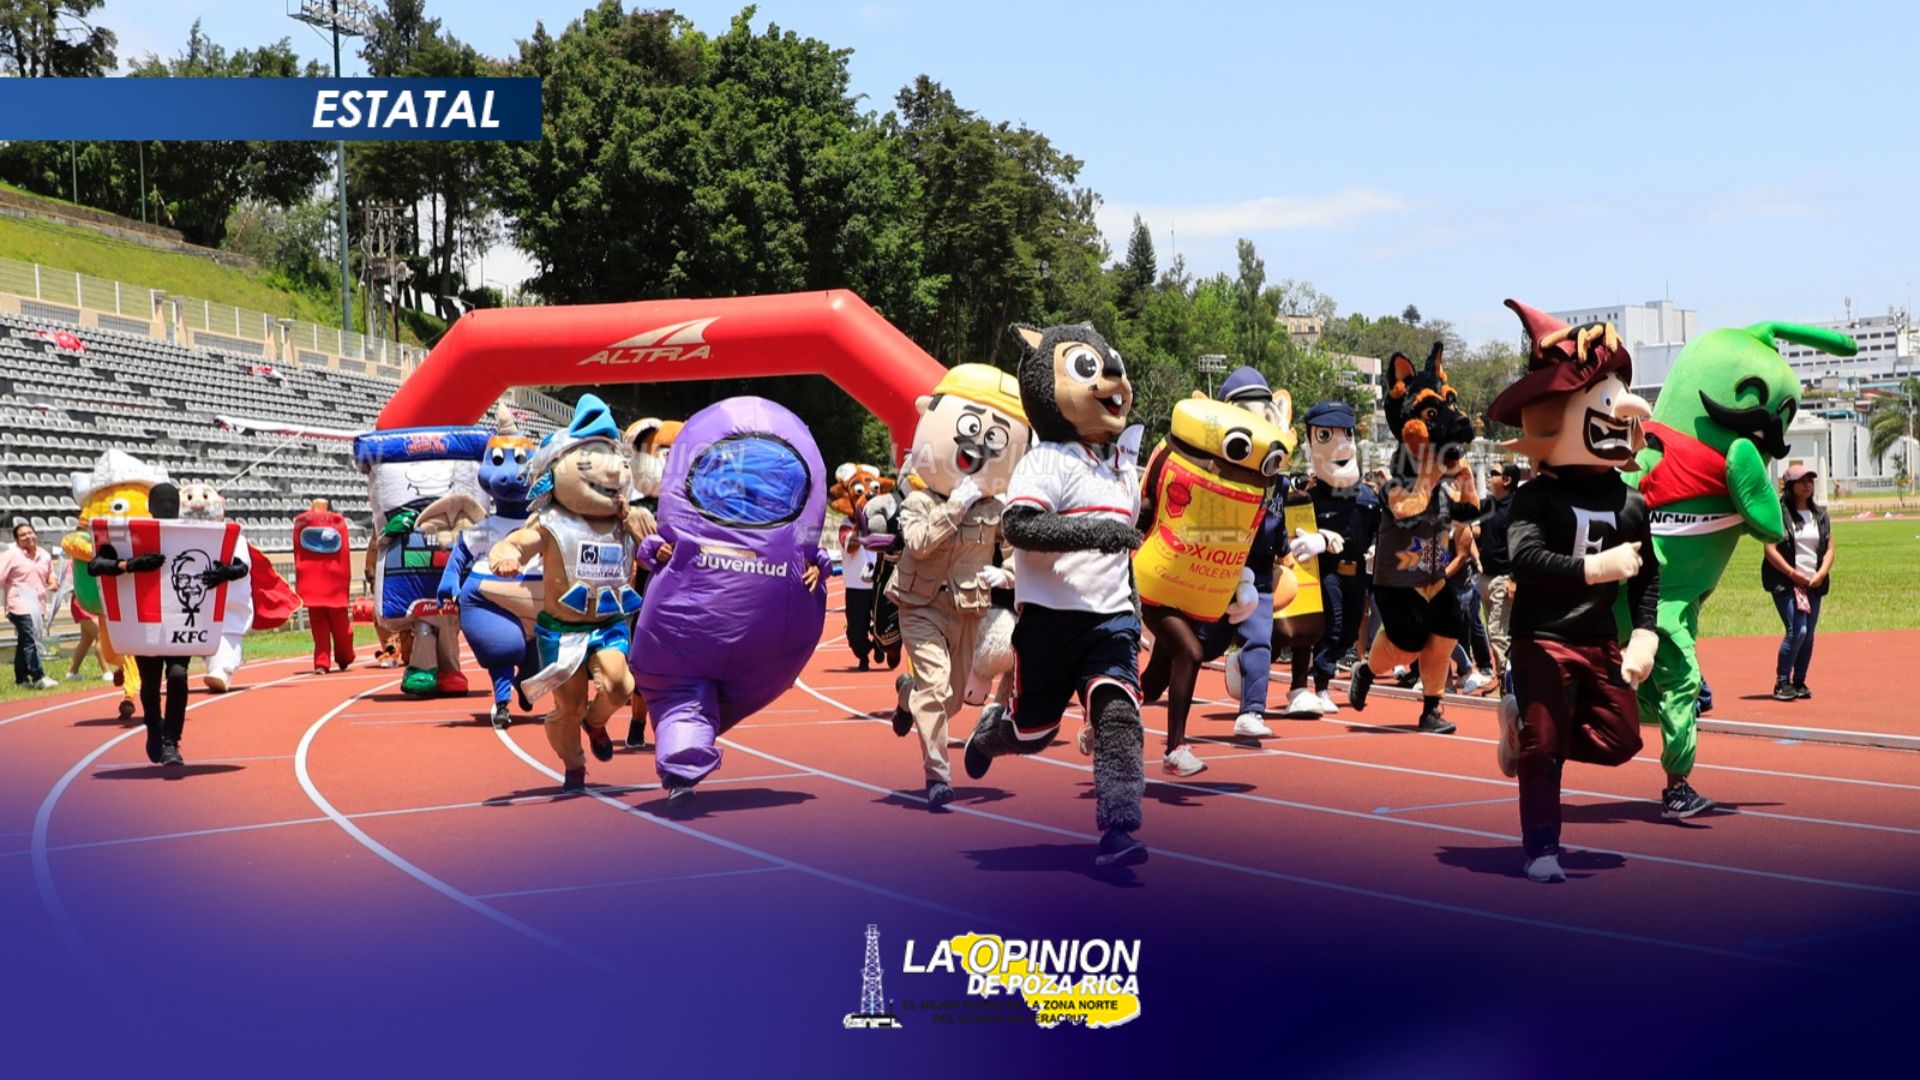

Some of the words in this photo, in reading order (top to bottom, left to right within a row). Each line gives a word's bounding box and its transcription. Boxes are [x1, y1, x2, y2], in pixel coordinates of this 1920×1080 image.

[576, 345, 710, 366] ALTRA
[697, 552, 787, 577] Juventud
[1189, 562, 1218, 578] MOLE
[171, 630, 208, 644] KFC
